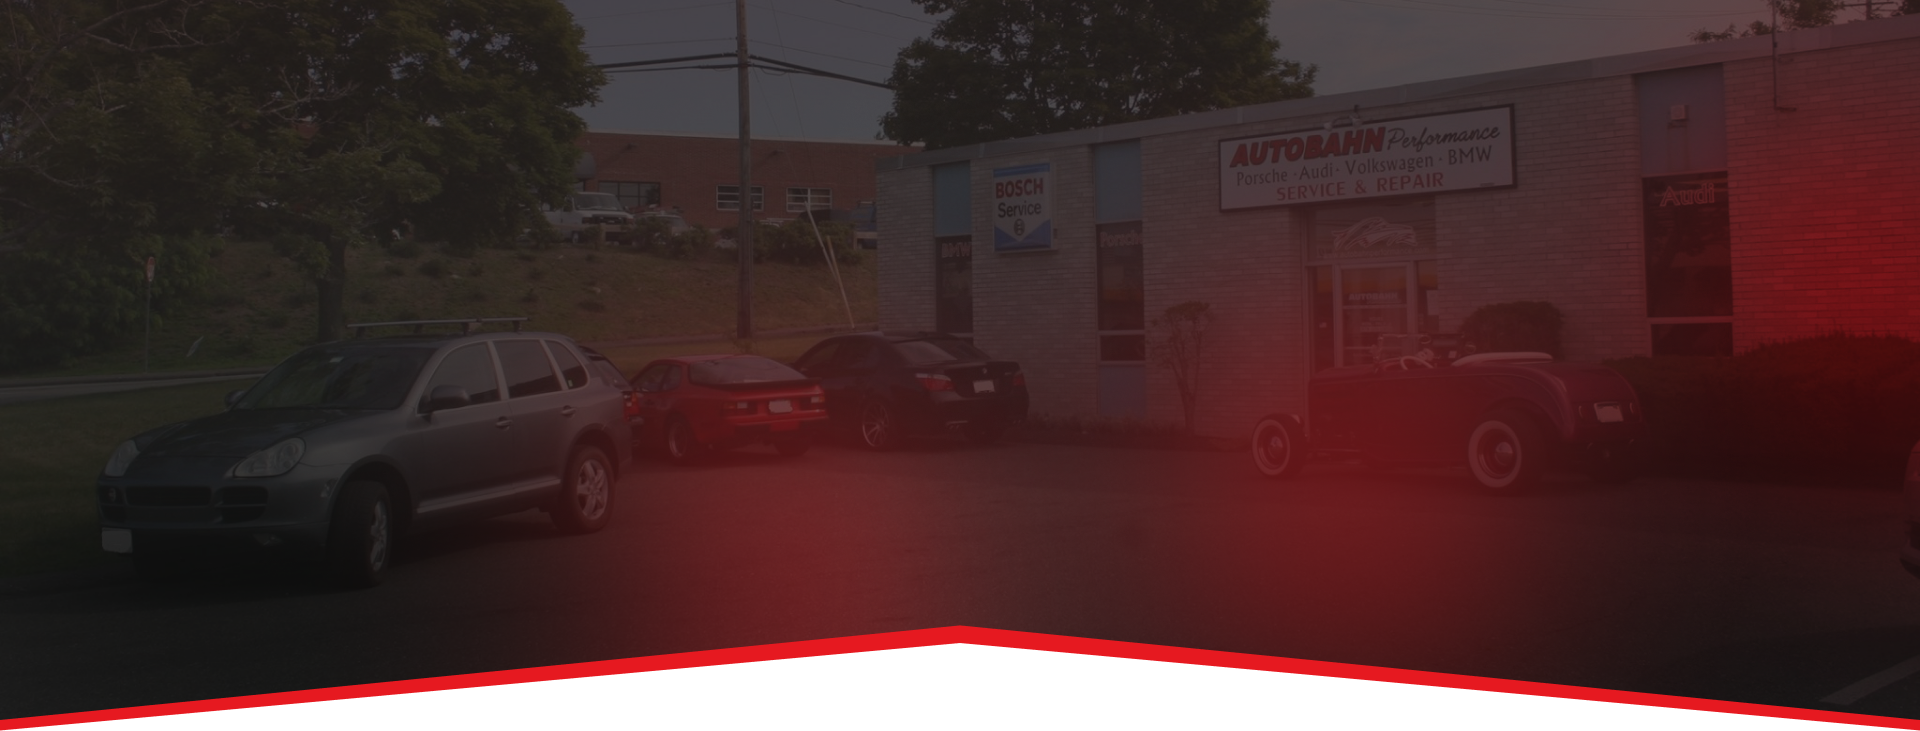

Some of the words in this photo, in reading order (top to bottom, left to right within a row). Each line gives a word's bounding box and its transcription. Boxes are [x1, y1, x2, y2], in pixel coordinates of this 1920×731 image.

[1229, 127, 1386, 168] AUTOBAHN
[1387, 126, 1501, 151] Performance
[1236, 169, 1288, 186] Porsche
[1299, 165, 1333, 181] Audi
[1345, 155, 1434, 176] Volkswagen
[1448, 145, 1493, 165] BMW
[995, 178, 1044, 198] BOSCH
[1276, 181, 1346, 201] SERVICE
[1354, 179, 1368, 195] &
[1377, 172, 1444, 193] REPAIR
[1659, 182, 1715, 207] Audi
[997, 201, 1042, 218] Service
[941, 242, 972, 258] BMW
[1349, 292, 1398, 301] AUTOBAHN
